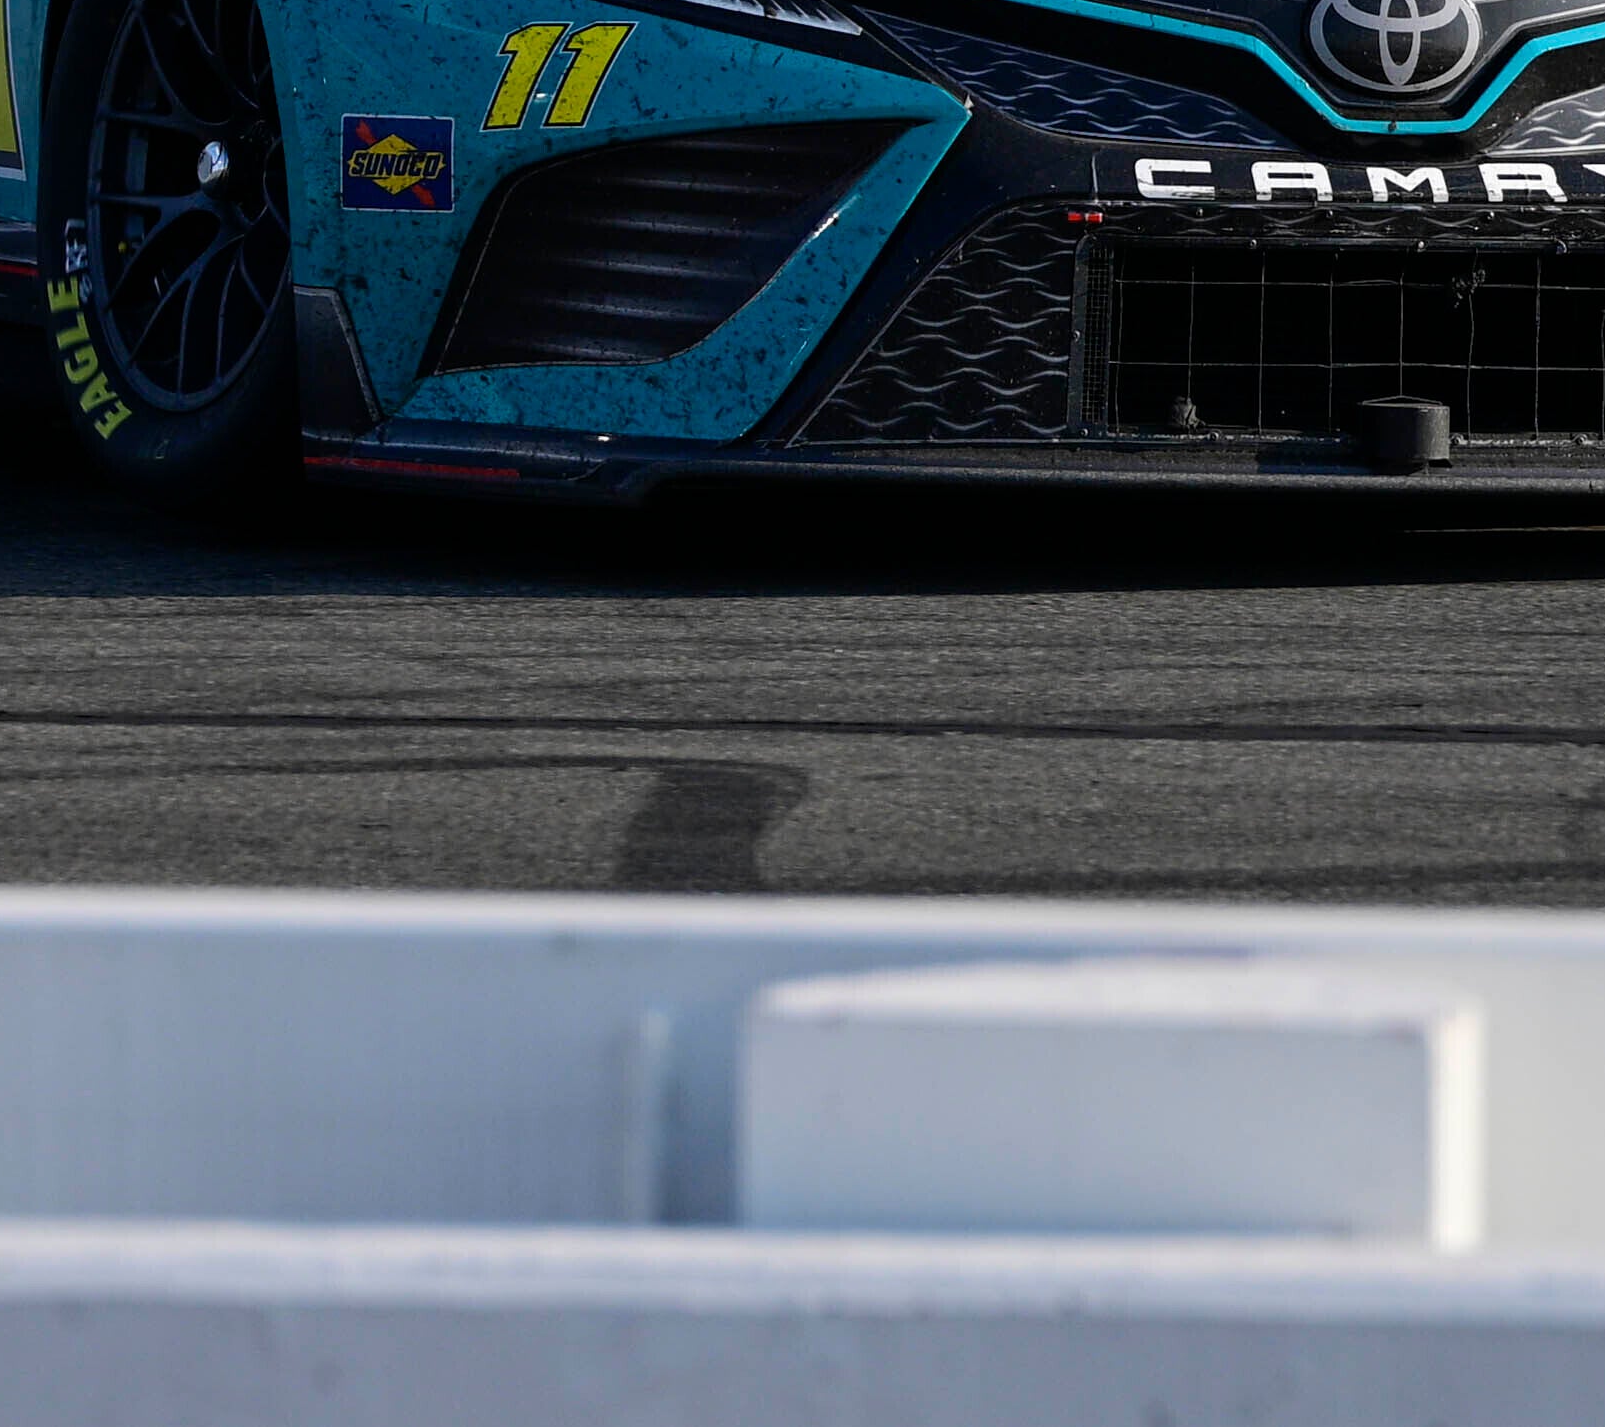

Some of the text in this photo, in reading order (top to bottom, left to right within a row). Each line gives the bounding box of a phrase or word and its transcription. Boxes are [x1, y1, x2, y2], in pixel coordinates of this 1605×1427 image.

[483, 21, 639, 132] 11
[349, 151, 444, 179] SUNOCO
[47, 275, 134, 440] EAGLE
